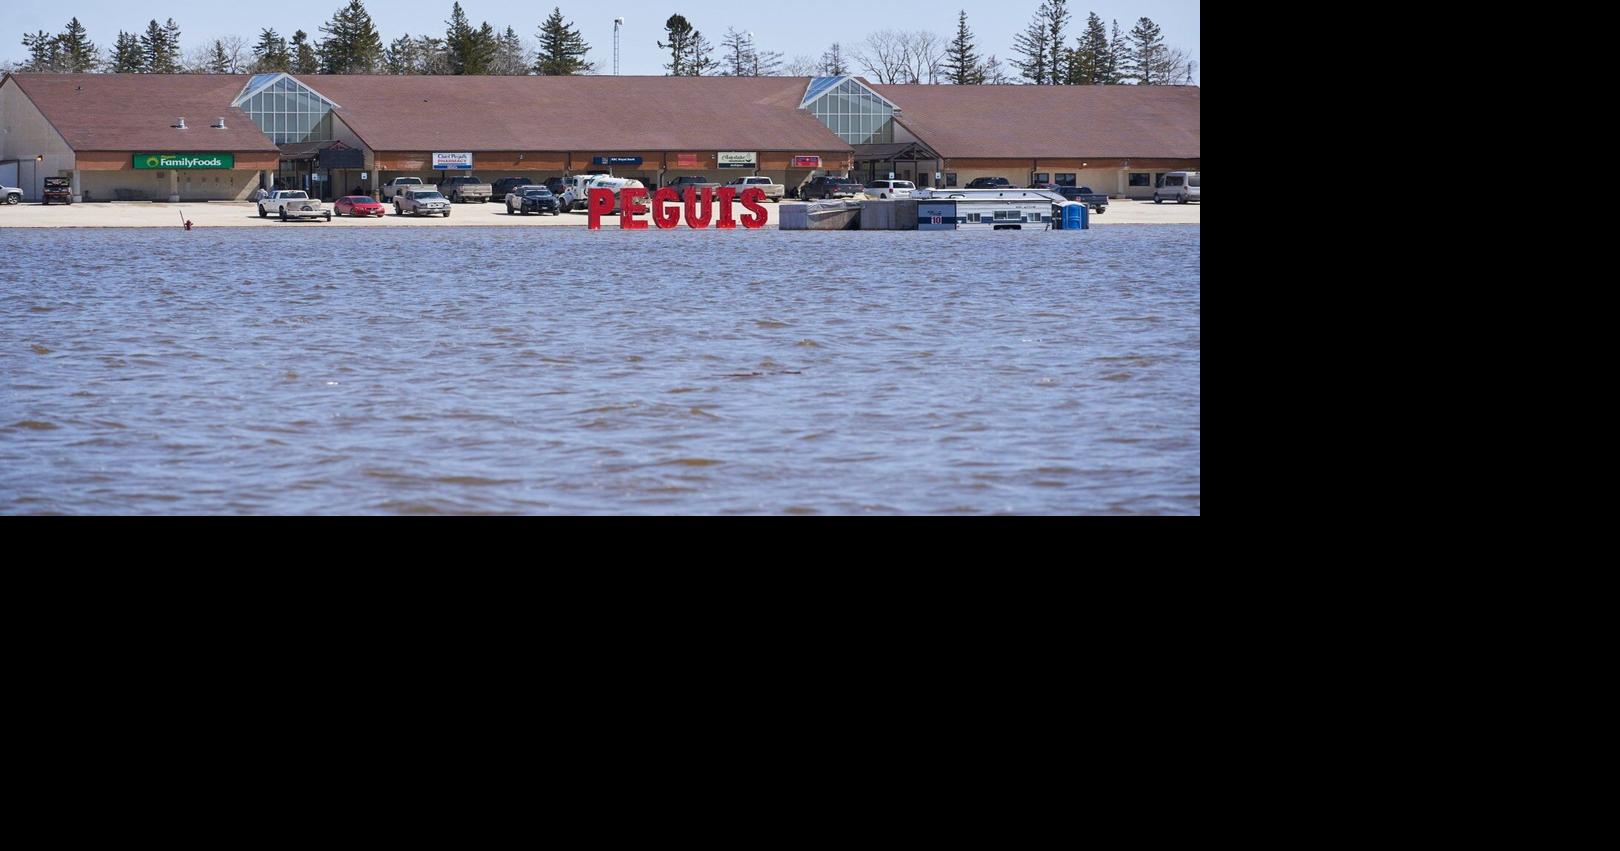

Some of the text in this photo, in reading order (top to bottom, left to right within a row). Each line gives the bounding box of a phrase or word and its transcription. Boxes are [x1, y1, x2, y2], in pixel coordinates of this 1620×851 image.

[160, 158, 222, 168] FamilyFoods
[587, 186, 768, 230] PEGUIS
[931, 216, 942, 224] 10
